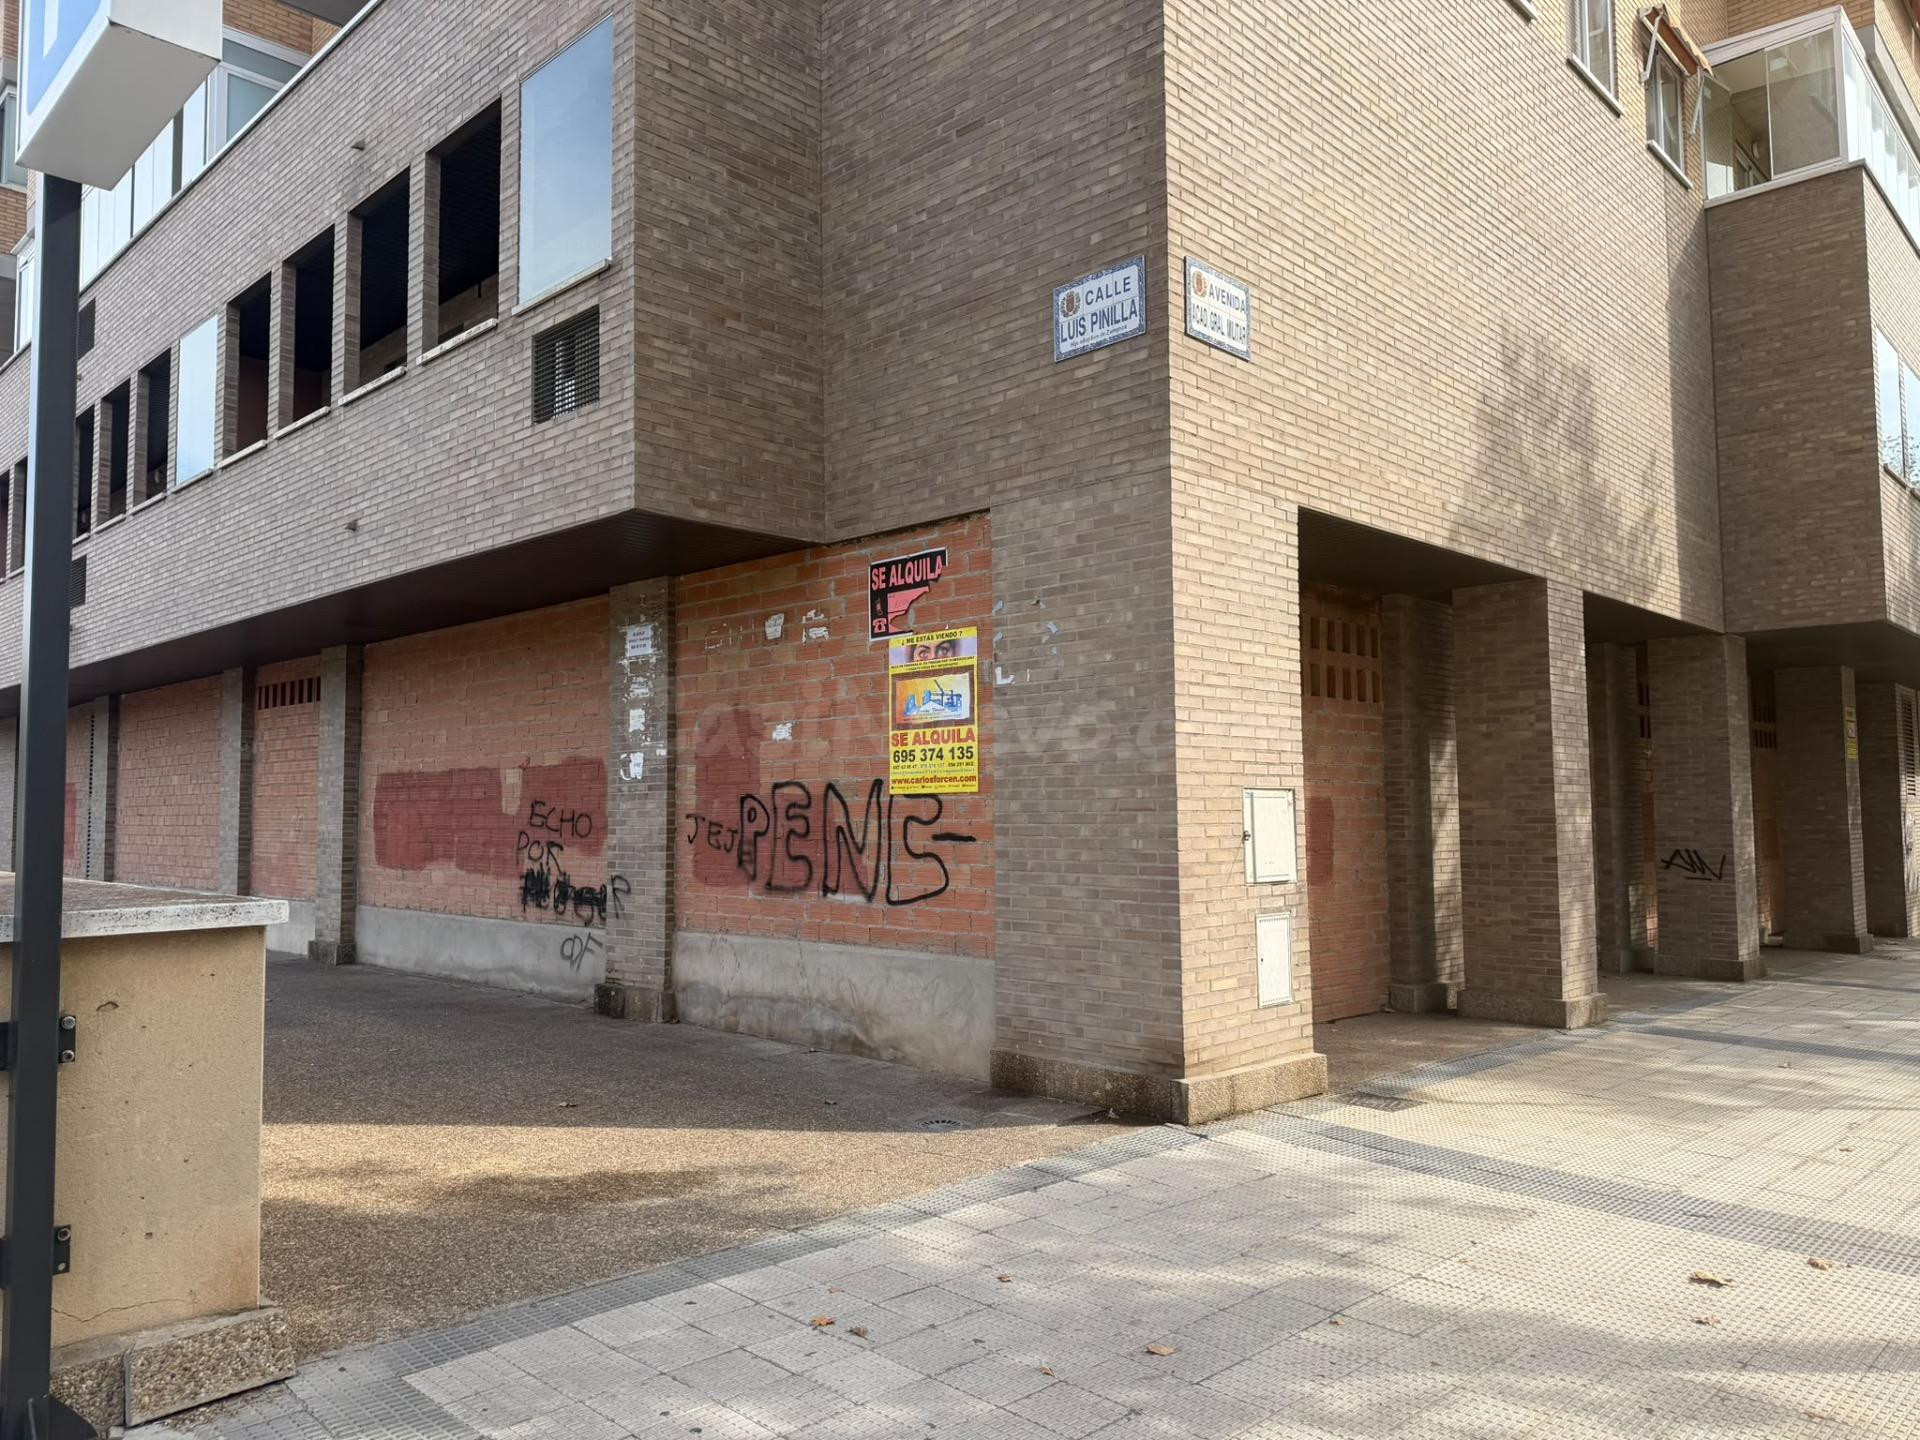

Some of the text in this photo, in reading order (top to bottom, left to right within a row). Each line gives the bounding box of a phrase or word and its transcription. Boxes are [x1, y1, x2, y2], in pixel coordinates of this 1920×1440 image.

[1085, 276, 1131, 306] CALLE
[1209, 283, 1246, 313] AVENIDA
[1060, 298, 1138, 343] LUIS PINILLA
[872, 555, 943, 590] SE ALQUILA
[935, 631, 957, 639] VIENDO
[891, 728, 975, 746] SE ALQUILA
[893, 746, 974, 763] 695 374 135
[891, 775, 976, 785] www.carlosforcen.com
[529, 800, 593, 838] ECHO
[516, 831, 564, 874] POR
